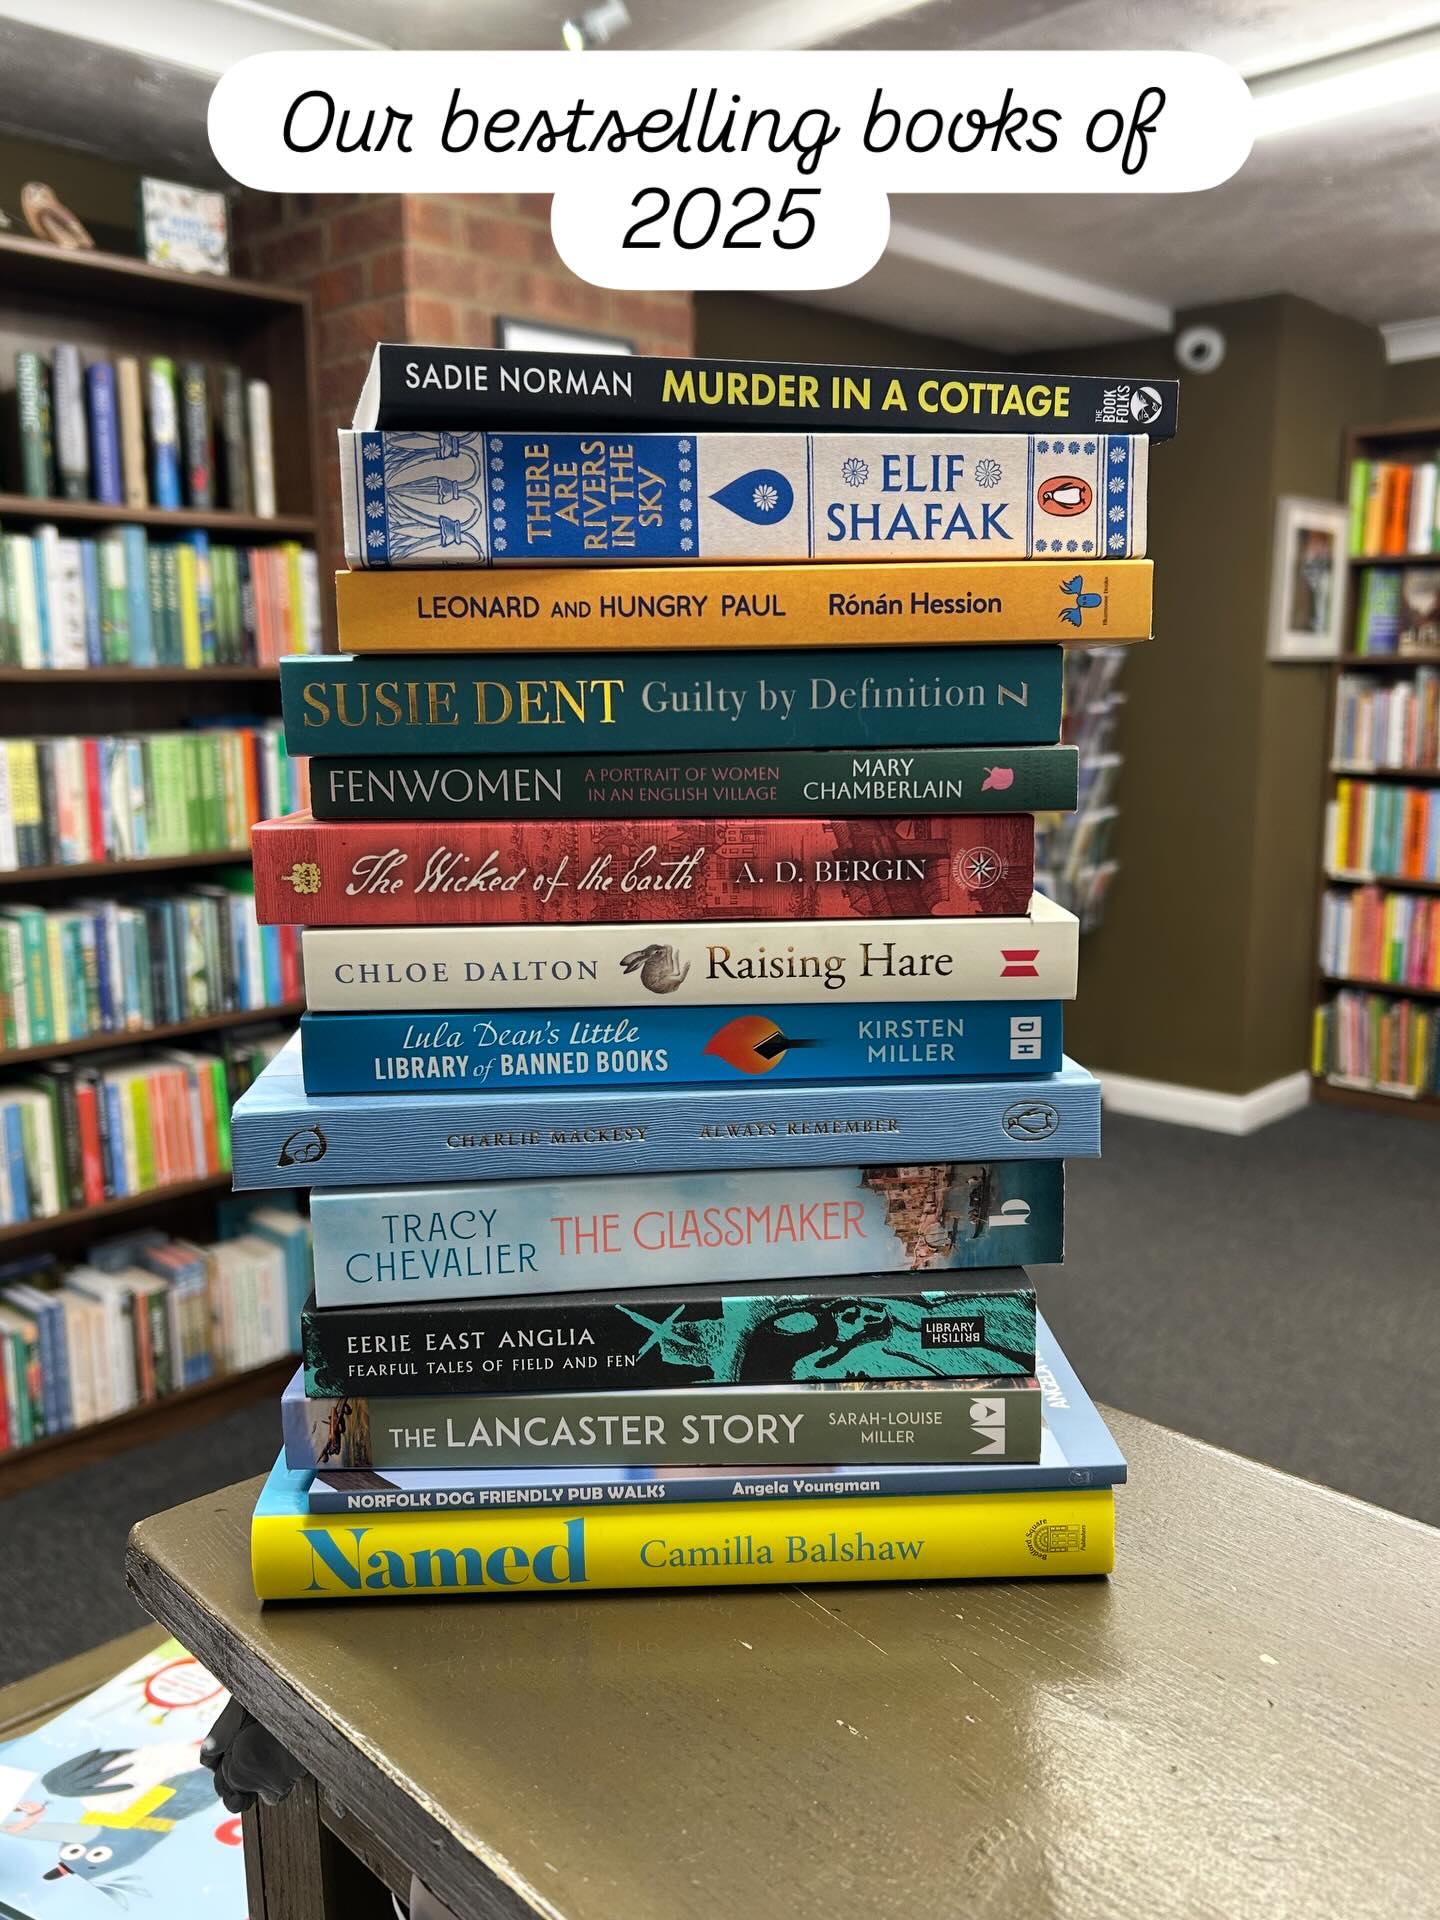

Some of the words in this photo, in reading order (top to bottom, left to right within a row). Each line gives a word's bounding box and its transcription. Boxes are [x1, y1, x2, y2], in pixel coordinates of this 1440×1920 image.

[405, 363, 488, 391] SADIE
[500, 367, 632, 397] NORMAN
[662, 369, 819, 408] MURDER
[832, 379, 870, 410] IN
[882, 379, 908, 411] A
[918, 380, 1070, 417] COTTAGE
[1095, 409, 1103, 423] THE
[1102, 389, 1117, 423] BOOK
[1115, 385, 1130, 423] FOLKS
[610, 443, 634, 506] THE
[881, 454, 964, 492] ELIF
[525, 443, 552, 544] THERE
[554, 462, 580, 526] ARE
[581, 441, 608, 551] RIVERS
[637, 466, 667, 527] SKY
[611, 515, 636, 548] IN
[826, 503, 1014, 542] SHAFAK
[417, 596, 540, 619] LEONARD
[550, 601, 591, 618] AND
[600, 595, 708, 617] HUNGRY
[722, 594, 786, 617] PAUL
[829, 591, 902, 616] Rónán
[911, 591, 1002, 615] Hession
[303, 680, 460, 728] SUSIE
[473, 679, 624, 727] DENT
[642, 680, 748, 720] Guilty
[759, 679, 798, 720] by
[809, 677, 985, 710] Definition
[584, 768, 599, 783] A
[601, 767, 680, 783] PORTRAIT
[686, 767, 707, 782] OF
[712, 767, 780, 781] WOMEN
[852, 758, 915, 776] MARY
[329, 768, 562, 803] FENWOMEN
[588, 789, 604, 802] IN
[611, 788, 634, 802] AN
[640, 788, 707, 801] ENGLISH
[712, 786, 777, 801] VILLAGE
[803, 780, 963, 800] CHAMBERLAIN
[345, 847, 408, 895] The
[414, 845, 525, 893] Wicked
[532, 854, 571, 902] of
[576, 854, 614, 892] the
[621, 845, 706, 892] Earth
[735, 863, 764, 884] A.
[775, 861, 804, 883] D.
[814, 859, 927, 882] BERGIN
[334, 962, 449, 984] CHLOE
[464, 960, 599, 983] DALTON
[706, 944, 846, 990] Raising
[859, 942, 954, 978] Hare
[402, 1020, 465, 1050] Lula
[473, 1020, 560, 1046] Dean's
[569, 1018, 640, 1045] Little
[858, 1019, 965, 1040] KIRSTEN
[374, 1055, 469, 1080] LIBRARY
[473, 1056, 497, 1084] of
[500, 1051, 590, 1076] BANNED
[596, 1049, 669, 1073] BOOKS
[867, 1043, 955, 1064] MILLER
[446, 1131, 540, 1149] CHARLIE
[550, 1127, 648, 1145] MACKESY
[700, 1122, 777, 1138] ALWAYS
[787, 1118, 900, 1136] REMEMBER
[382, 1209, 498, 1244] TRACY
[551, 1214, 621, 1255] THE
[634, 1201, 868, 1251] GLASSMAKER
[346, 1243, 538, 1283] CHEVALIER
[347, 1334, 412, 1354] EERIE
[426, 1332, 485, 1351] EAST
[498, 1329, 595, 1348] ANGLIA
[926, 1322, 974, 1333] LIBRARY
[932, 1332, 980, 1343] BRITISH
[348, 1360, 418, 1378] FEARFUL
[427, 1361, 474, 1375] TALES
[482, 1359, 504, 1373] OF
[512, 1357, 554, 1371] FIELD
[562, 1355, 598, 1369] AND
[607, 1355, 636, 1368] FEN
[388, 1428, 437, 1448] THE
[446, 1416, 666, 1448] LANCASTER
[682, 1413, 805, 1445] STORY
[828, 1411, 943, 1426] SARAH-LOUISE
[860, 1430, 915, 1443] MILLER
[348, 1493, 431, 1509] NORFOLK
[436, 1491, 473, 1506] DOG
[479, 1488, 564, 1504] FRIENDLY
[567, 1486, 603, 1501] PUB
[607, 1484, 666, 1499] WALKS
[732, 1481, 789, 1496] Angela
[793, 1479, 880, 1495] Youngman
[1026, 1519, 1047, 1538] Square
[297, 1517, 590, 1592] Named
[640, 1536, 773, 1569] Camilla
[786, 1532, 925, 1564] Balshaw
[1026, 1539, 1047, 1560] Bedford
